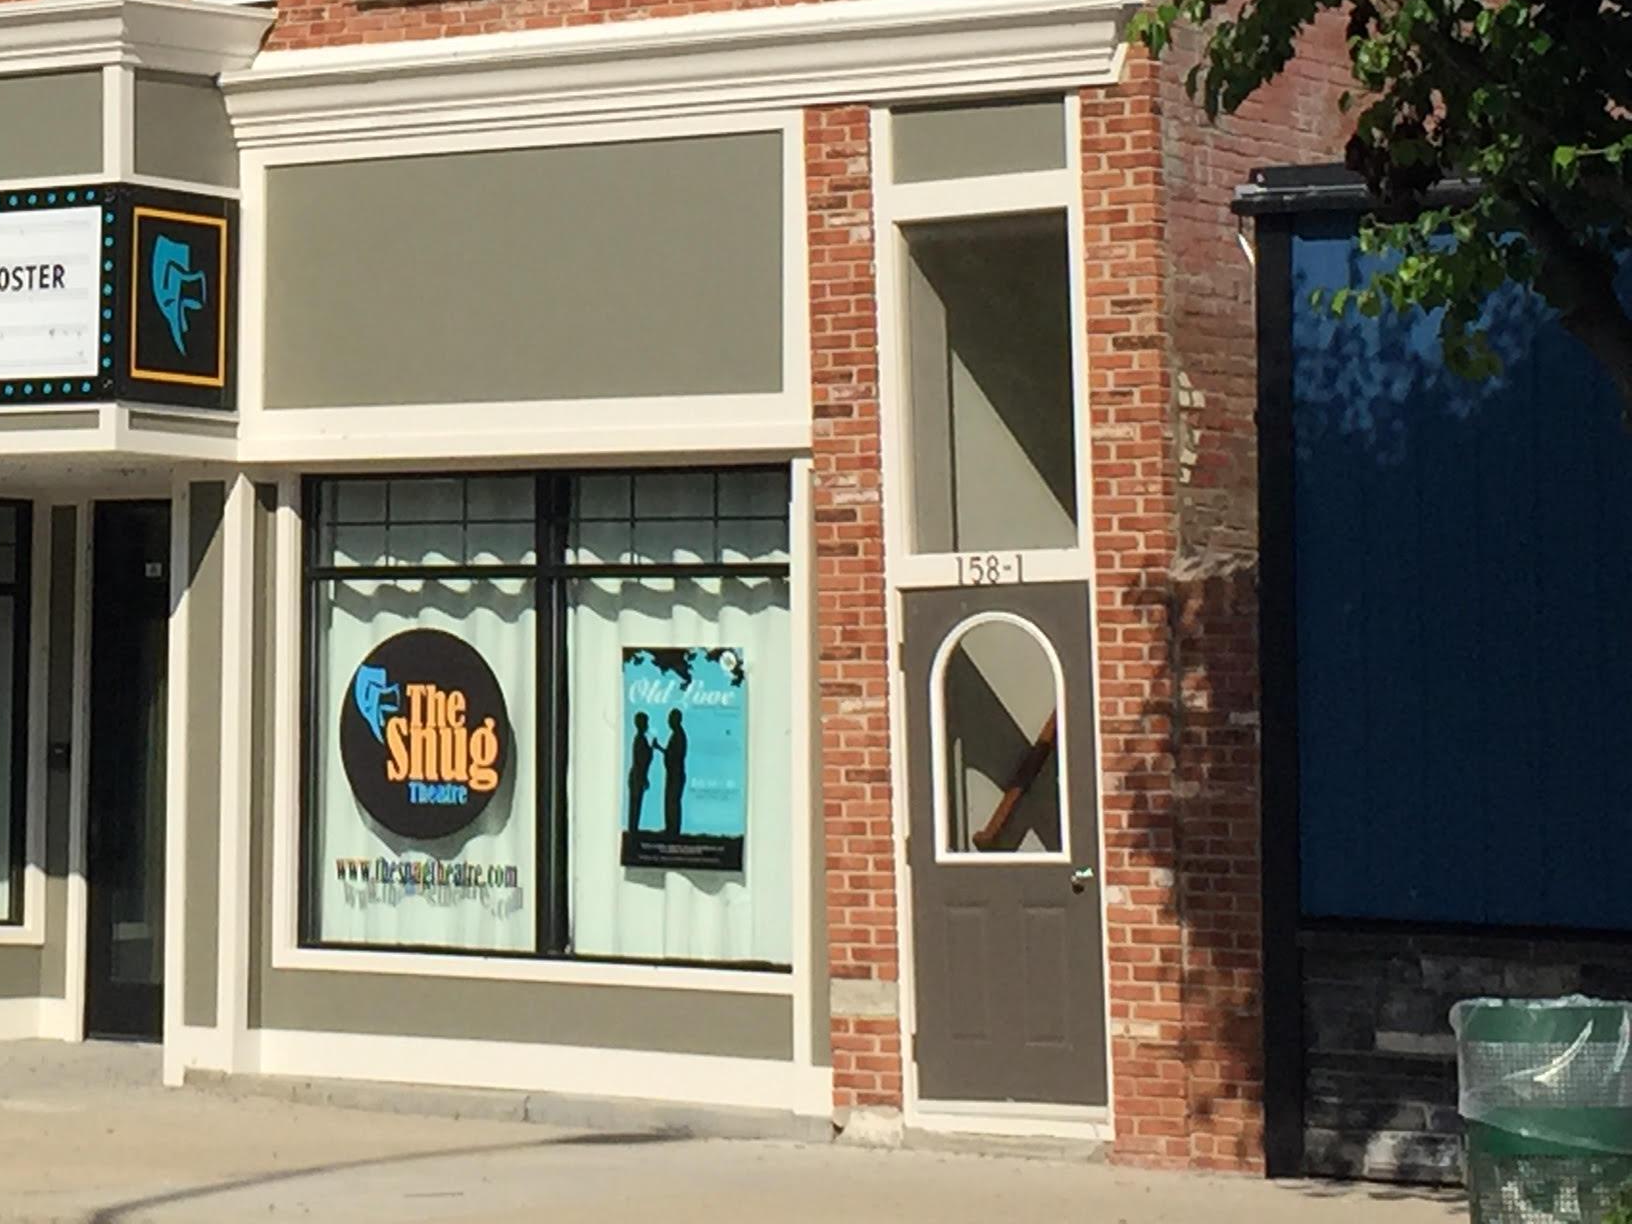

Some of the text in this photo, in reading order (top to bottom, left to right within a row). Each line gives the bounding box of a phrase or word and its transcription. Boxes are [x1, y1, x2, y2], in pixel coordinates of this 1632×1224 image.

[956, 554, 1024, 584] 158-1
[405, 683, 467, 728] The
[386, 715, 500, 791] Snug
[408, 780, 469, 806] Theatre
